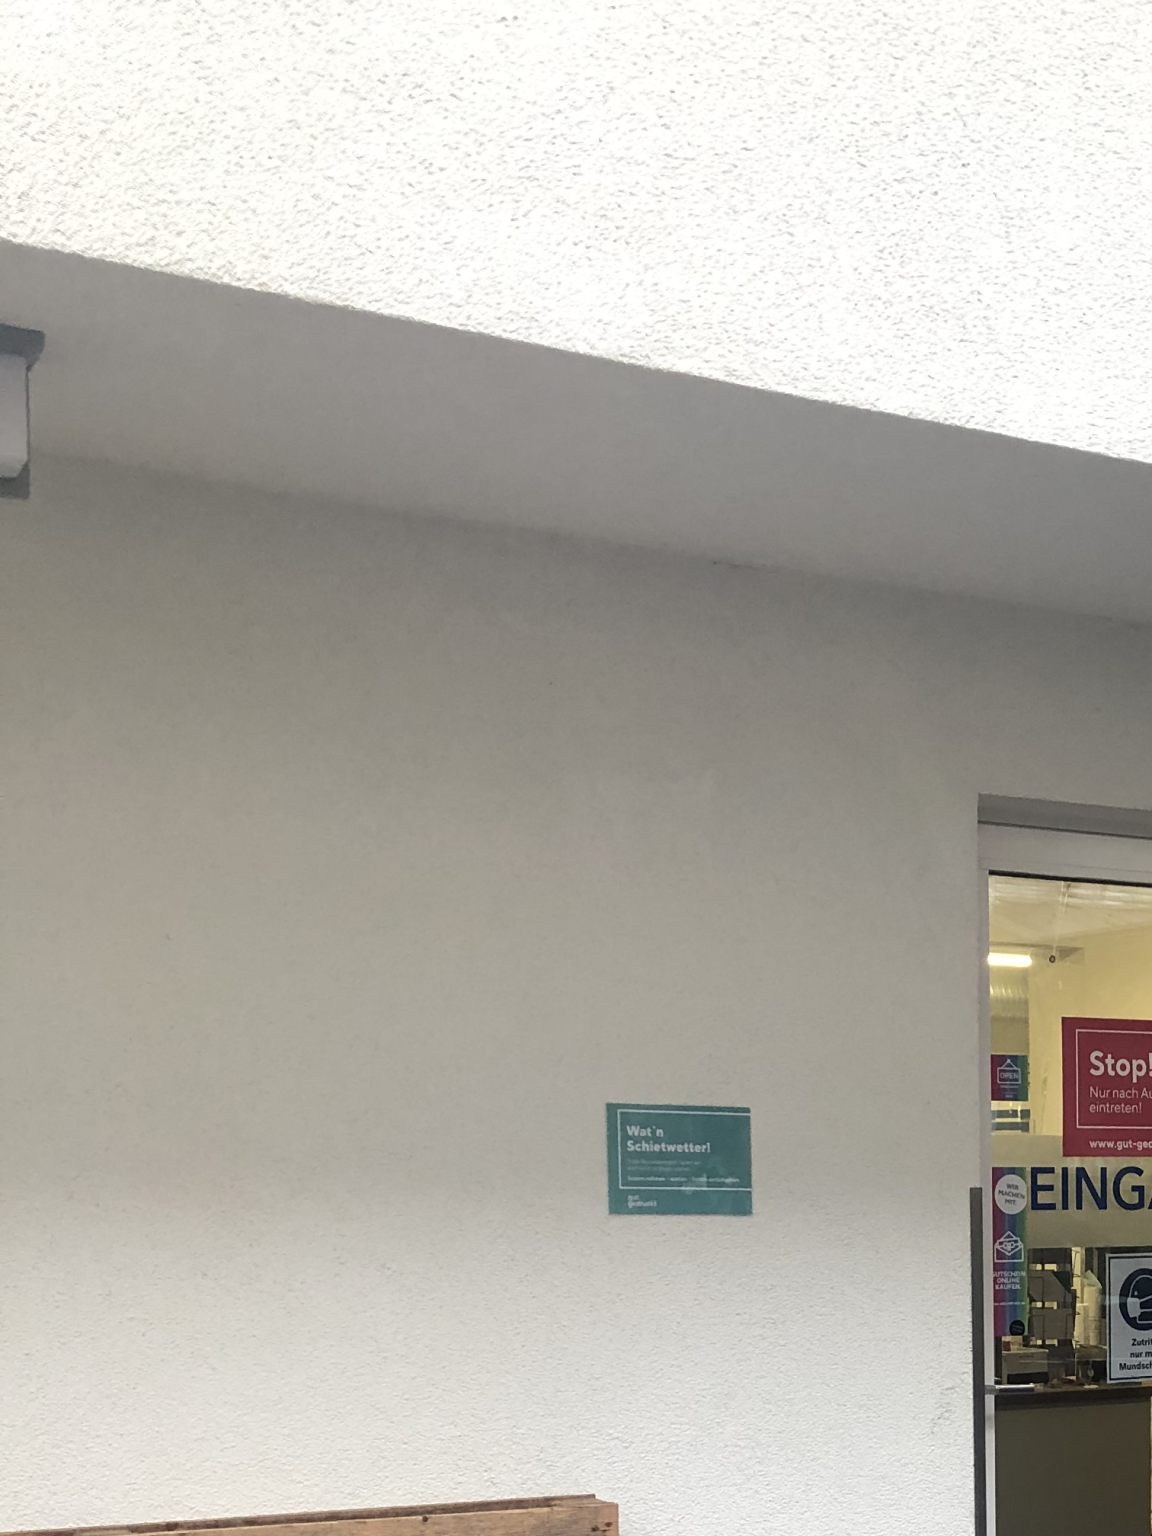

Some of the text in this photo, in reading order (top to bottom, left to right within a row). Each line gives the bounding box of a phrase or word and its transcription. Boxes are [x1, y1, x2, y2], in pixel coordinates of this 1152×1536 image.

[1089, 1086, 1111, 1098] Nur
[1113, 1087, 1139, 1099] nach
[1089, 1102, 1142, 1113] eintreten!
[626, 1140, 711, 1153] Schietwetter!
